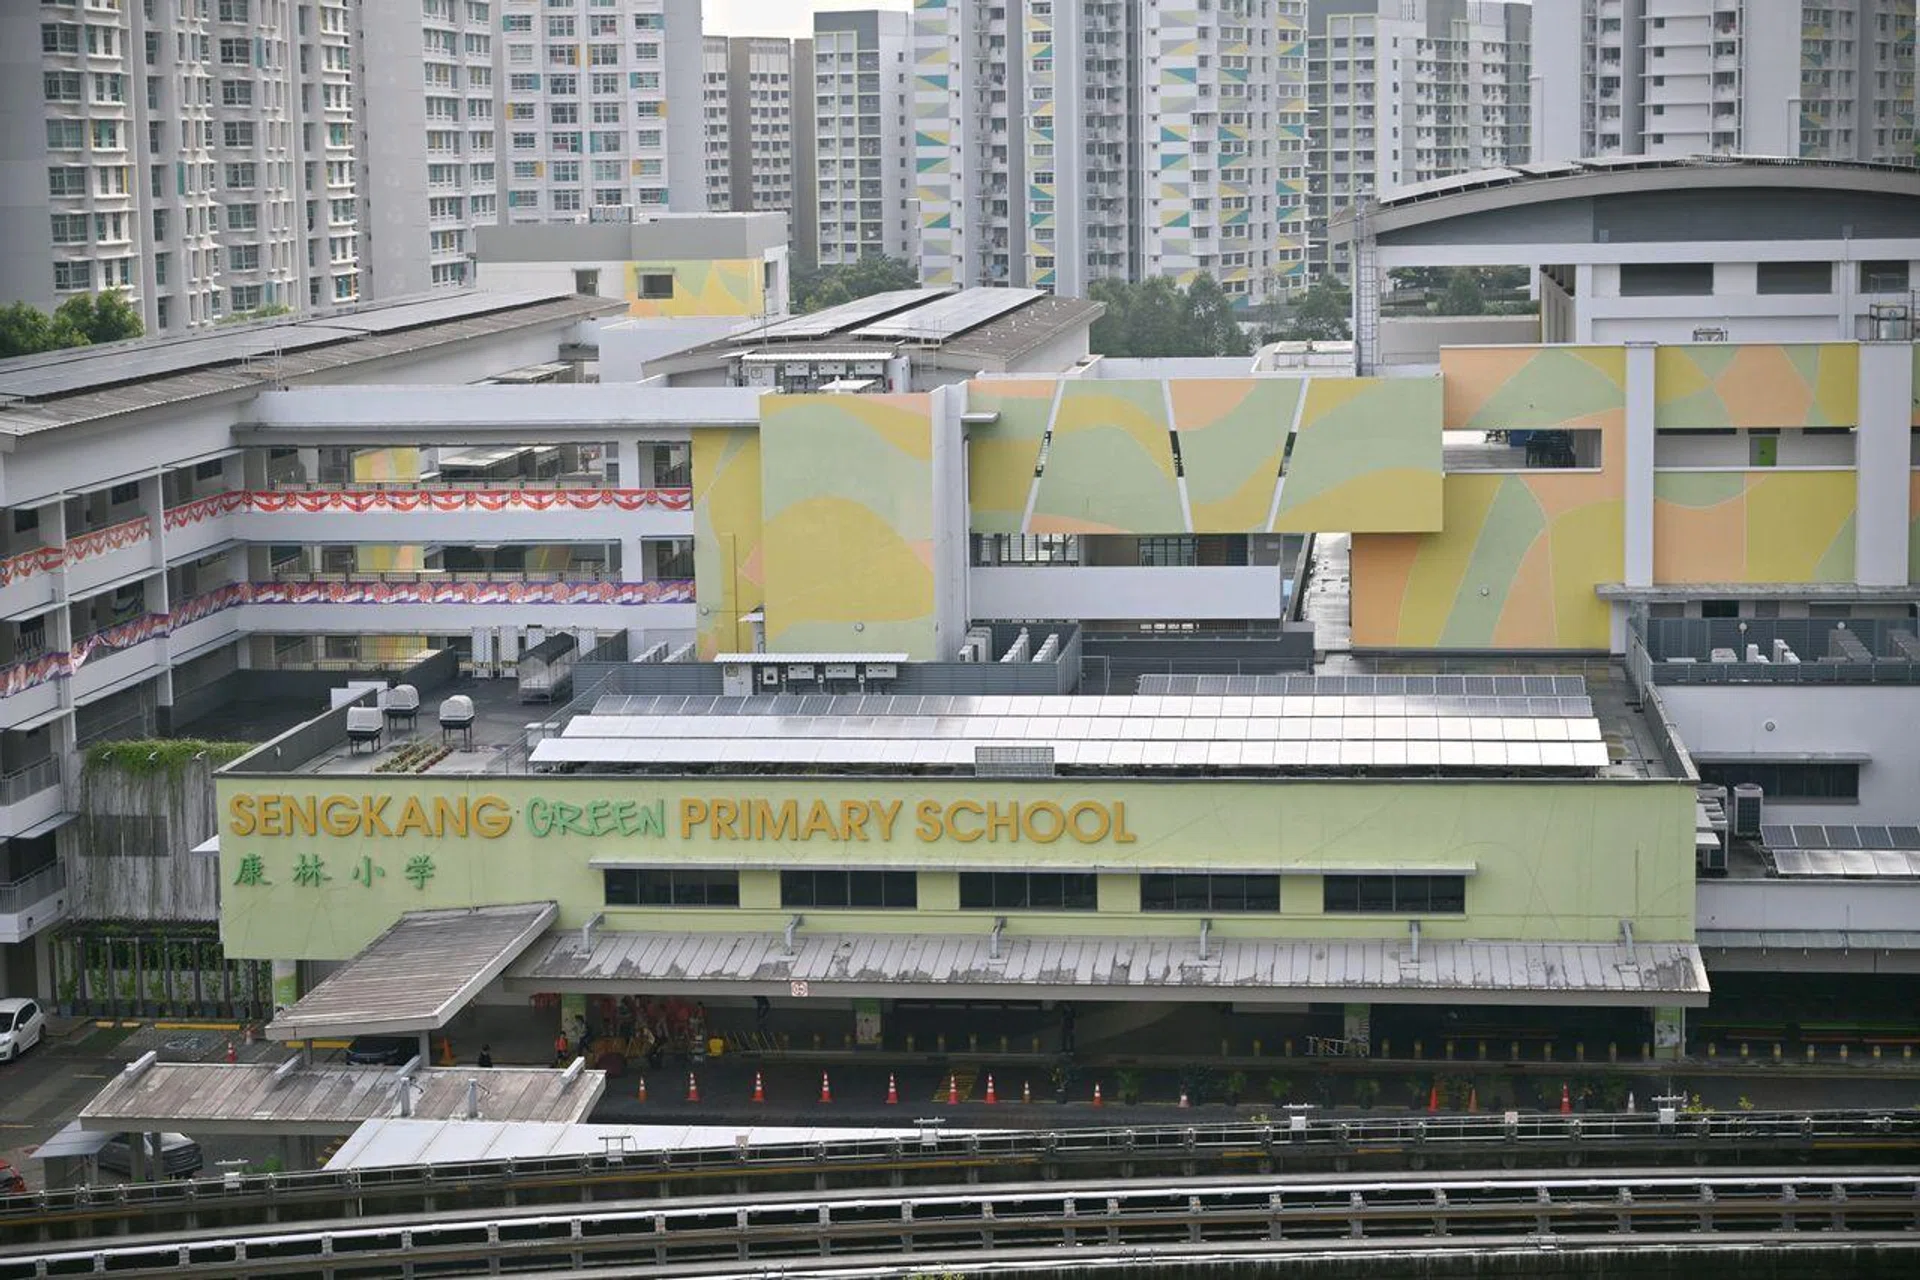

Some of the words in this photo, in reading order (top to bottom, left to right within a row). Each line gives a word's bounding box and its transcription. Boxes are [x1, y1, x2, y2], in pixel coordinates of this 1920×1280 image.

[229, 794, 512, 839] SENGKANG
[525, 796, 668, 839] GREEN
[680, 797, 902, 841] PRIMARY
[915, 799, 1137, 844] SCHOOL
[234, 851, 436, 890] 康林小学
